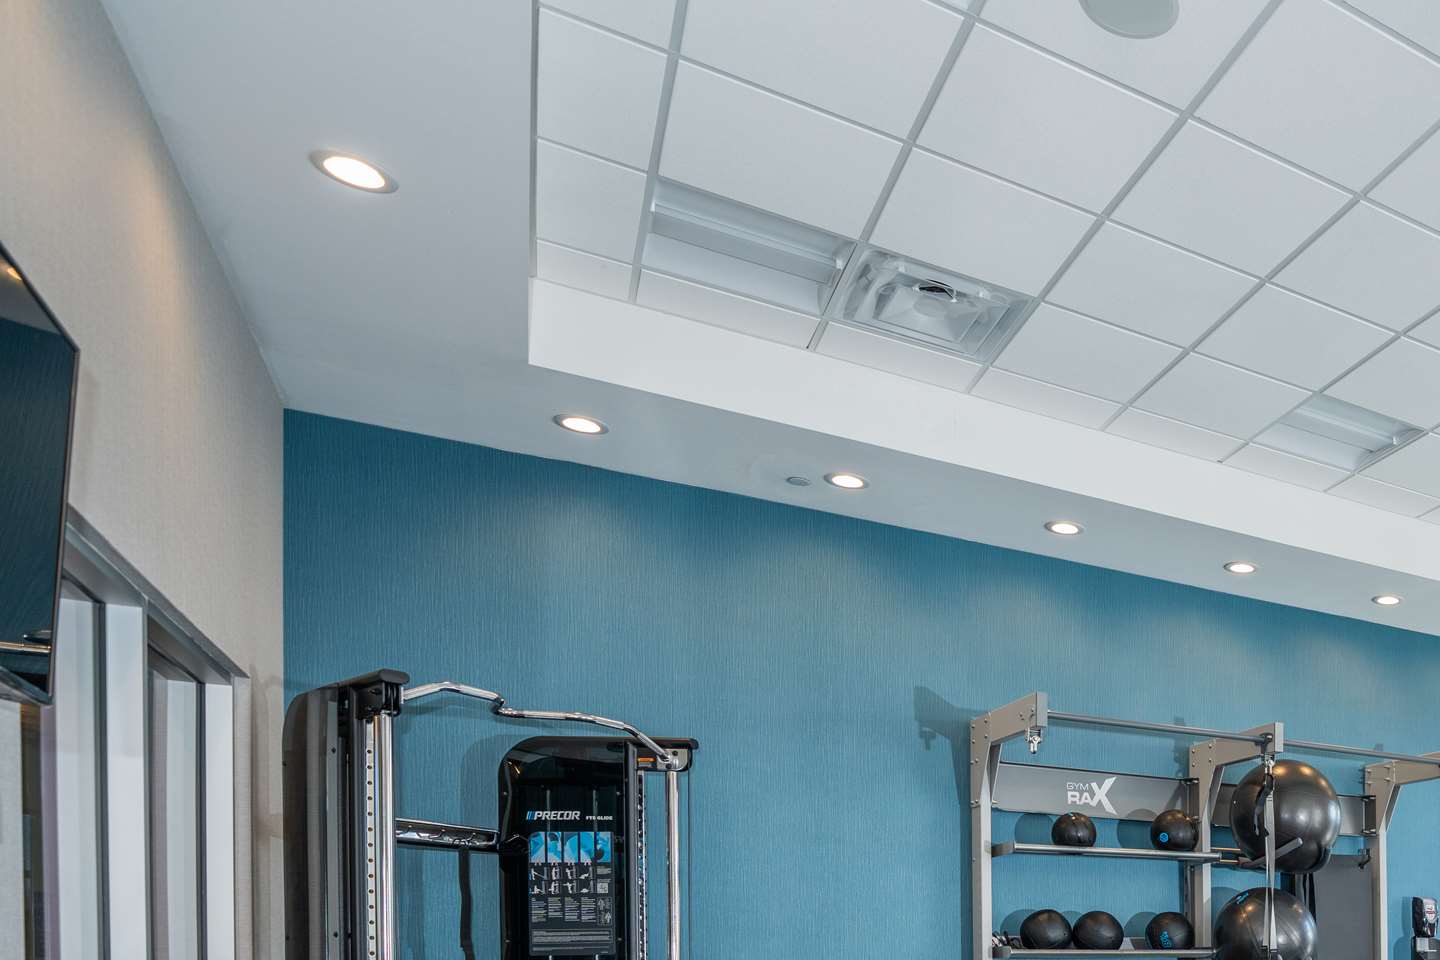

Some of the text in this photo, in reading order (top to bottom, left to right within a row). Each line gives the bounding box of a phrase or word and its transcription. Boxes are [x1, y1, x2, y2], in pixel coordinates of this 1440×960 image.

[1066, 782, 1089, 791] GYM
[1067, 776, 1118, 815] RAX
[533, 810, 581, 820] PRECOR
